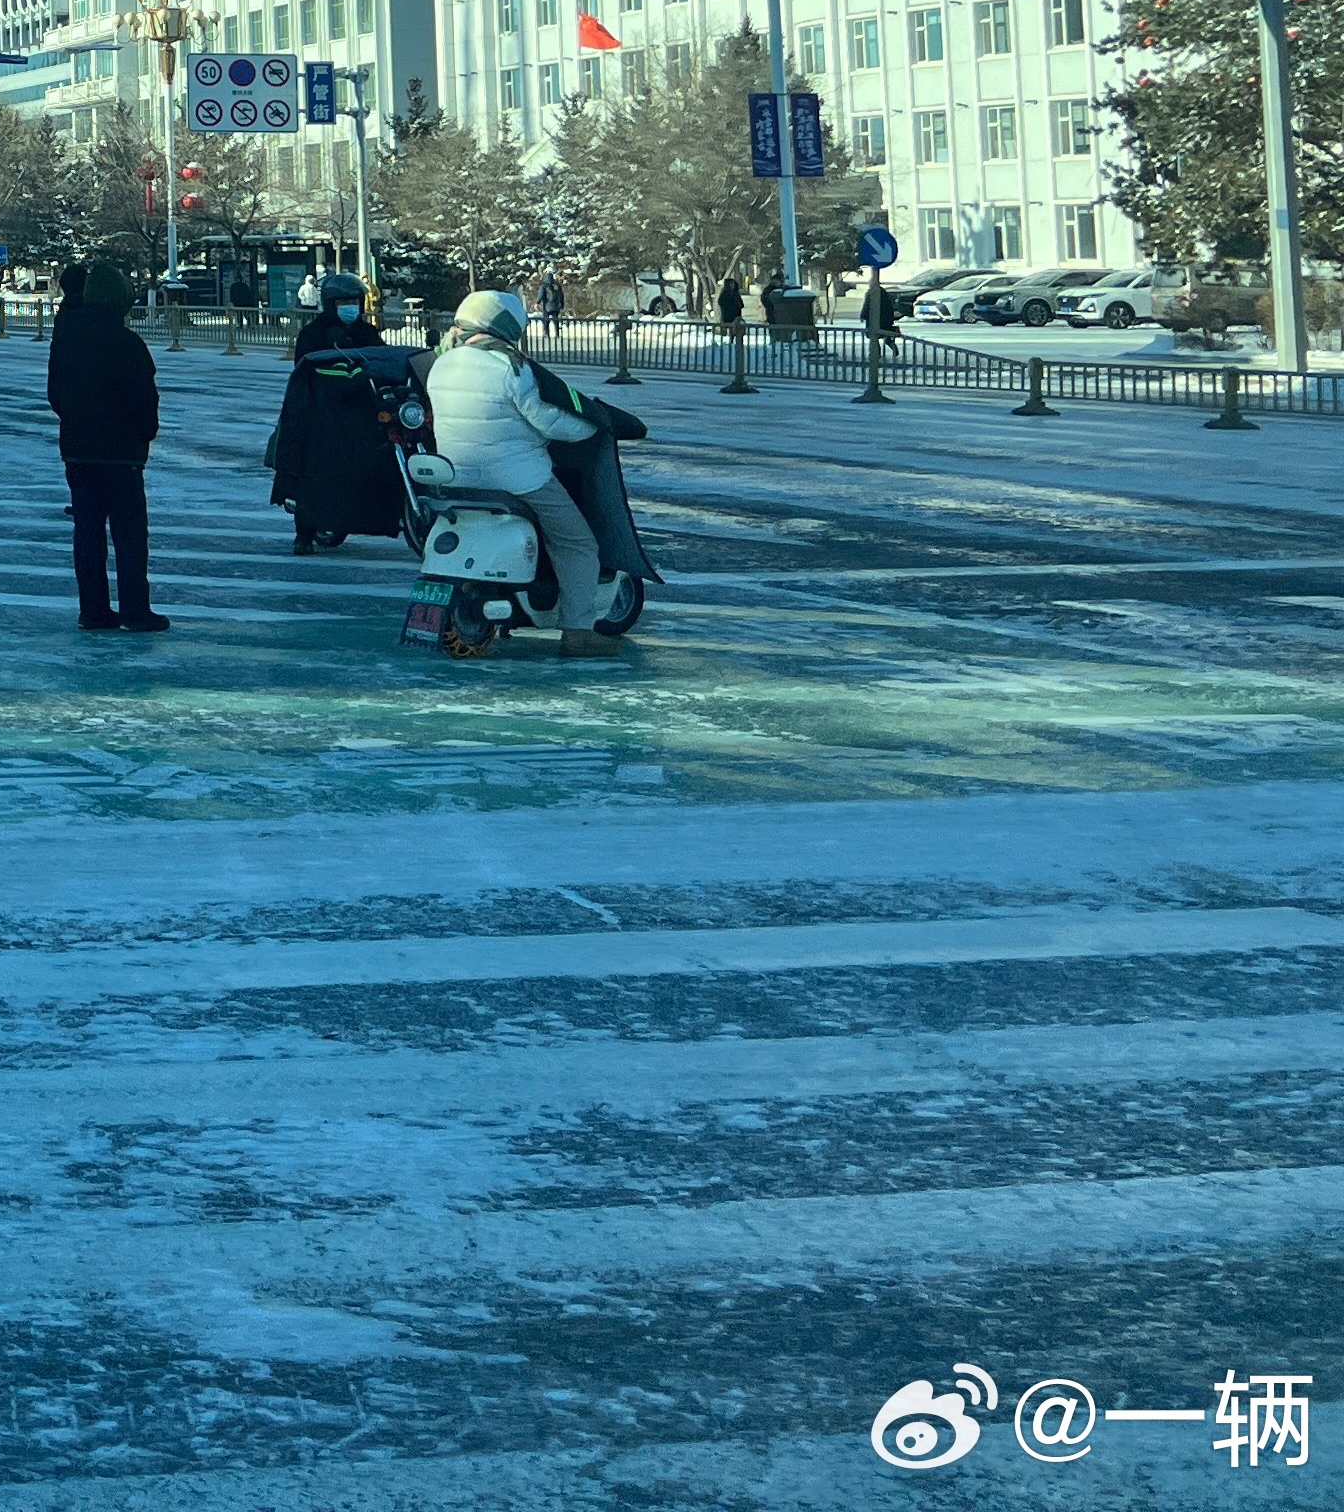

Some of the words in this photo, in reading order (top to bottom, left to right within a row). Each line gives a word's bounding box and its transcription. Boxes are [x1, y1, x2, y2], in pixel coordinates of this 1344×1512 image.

[201, 66, 217, 79] 50
[312, 65, 329, 120] 严管街
